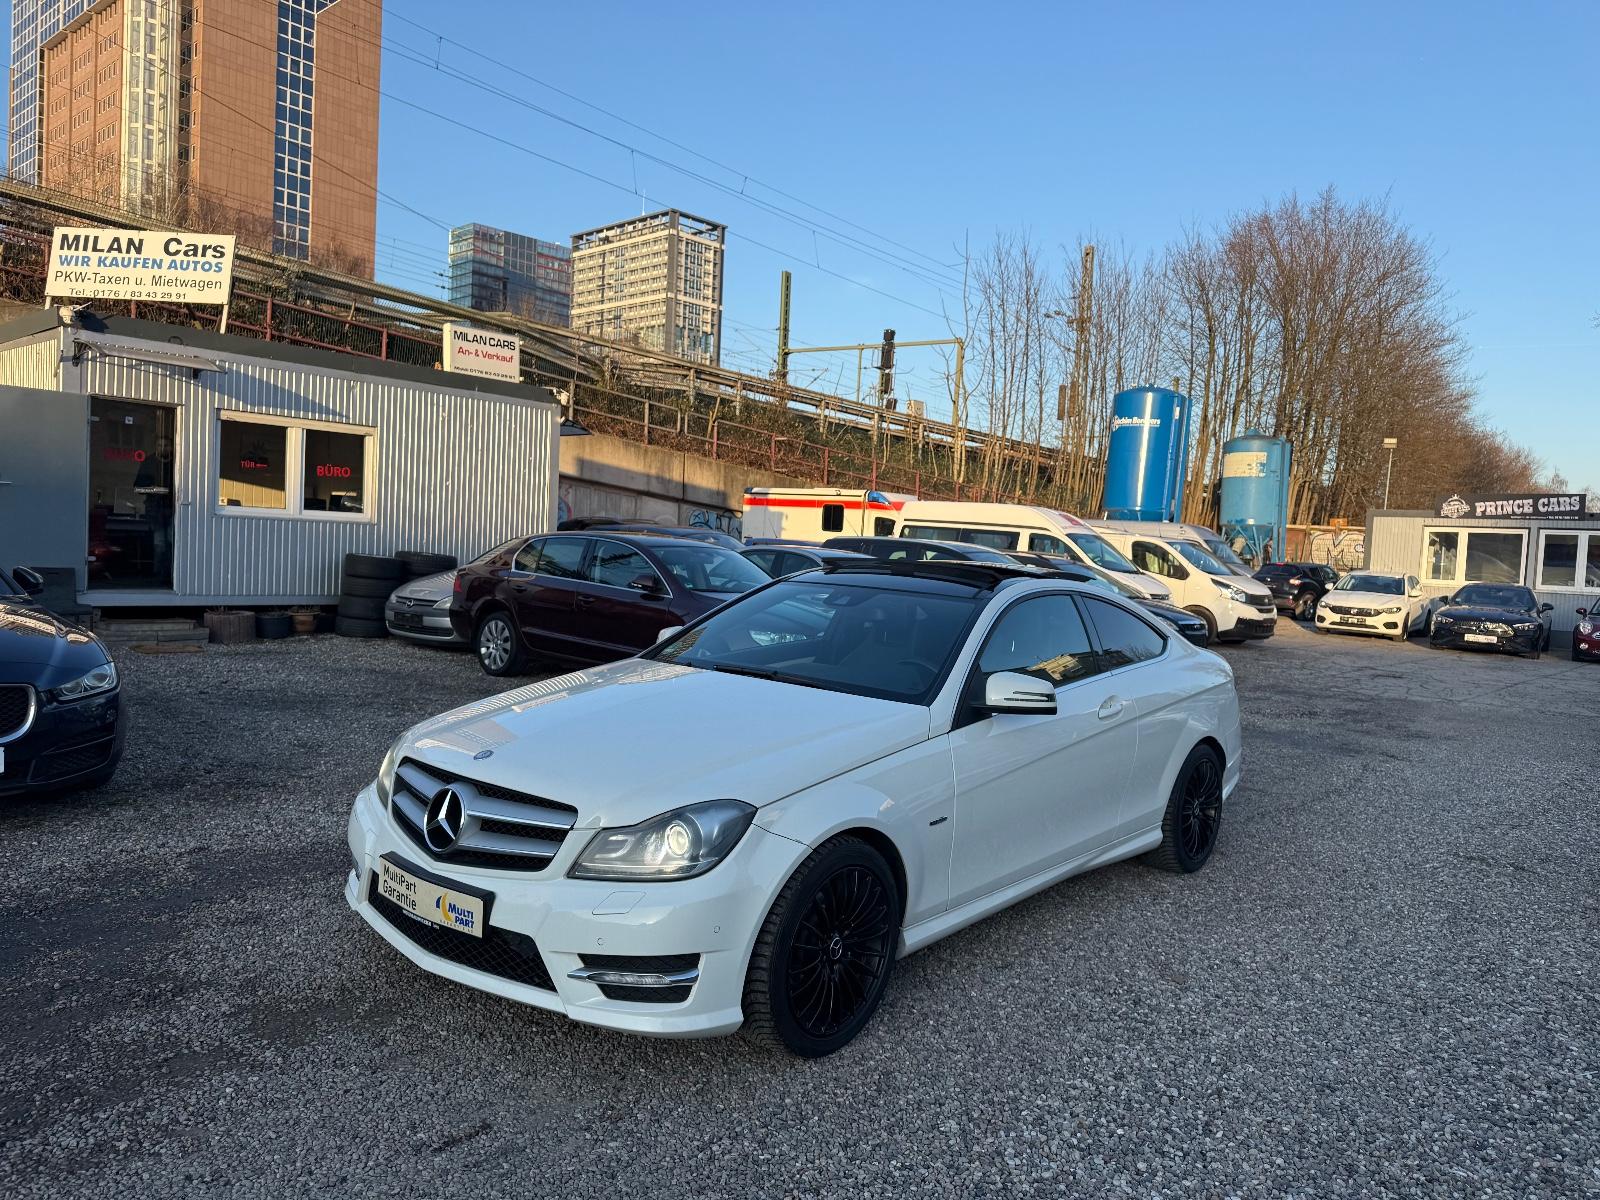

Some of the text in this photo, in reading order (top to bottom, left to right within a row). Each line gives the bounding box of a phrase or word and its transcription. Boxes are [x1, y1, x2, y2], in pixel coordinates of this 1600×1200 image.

[60, 234, 226, 259] MILAN Cars
[58, 255, 223, 273] WIR KAUFEN AUTOS
[54, 270, 222, 291] PKW-Taxen u. Mietwagen
[145, 291, 157, 299] 43
[175, 292, 187, 300] 91
[454, 330, 516, 351] MILAN CARS
[457, 346, 514, 363] An- & Verkauf
[240, 460, 255, 469] TÜR
[316, 463, 351, 478] BÜRO
[1475, 499, 1534, 517] PRINCE
[1537, 495, 1580, 513] CARS
[383, 864, 417, 895] MultiPart
[382, 879, 417, 911] Garantie
[448, 902, 474, 919] MULTI
[454, 915, 475, 929] PART
